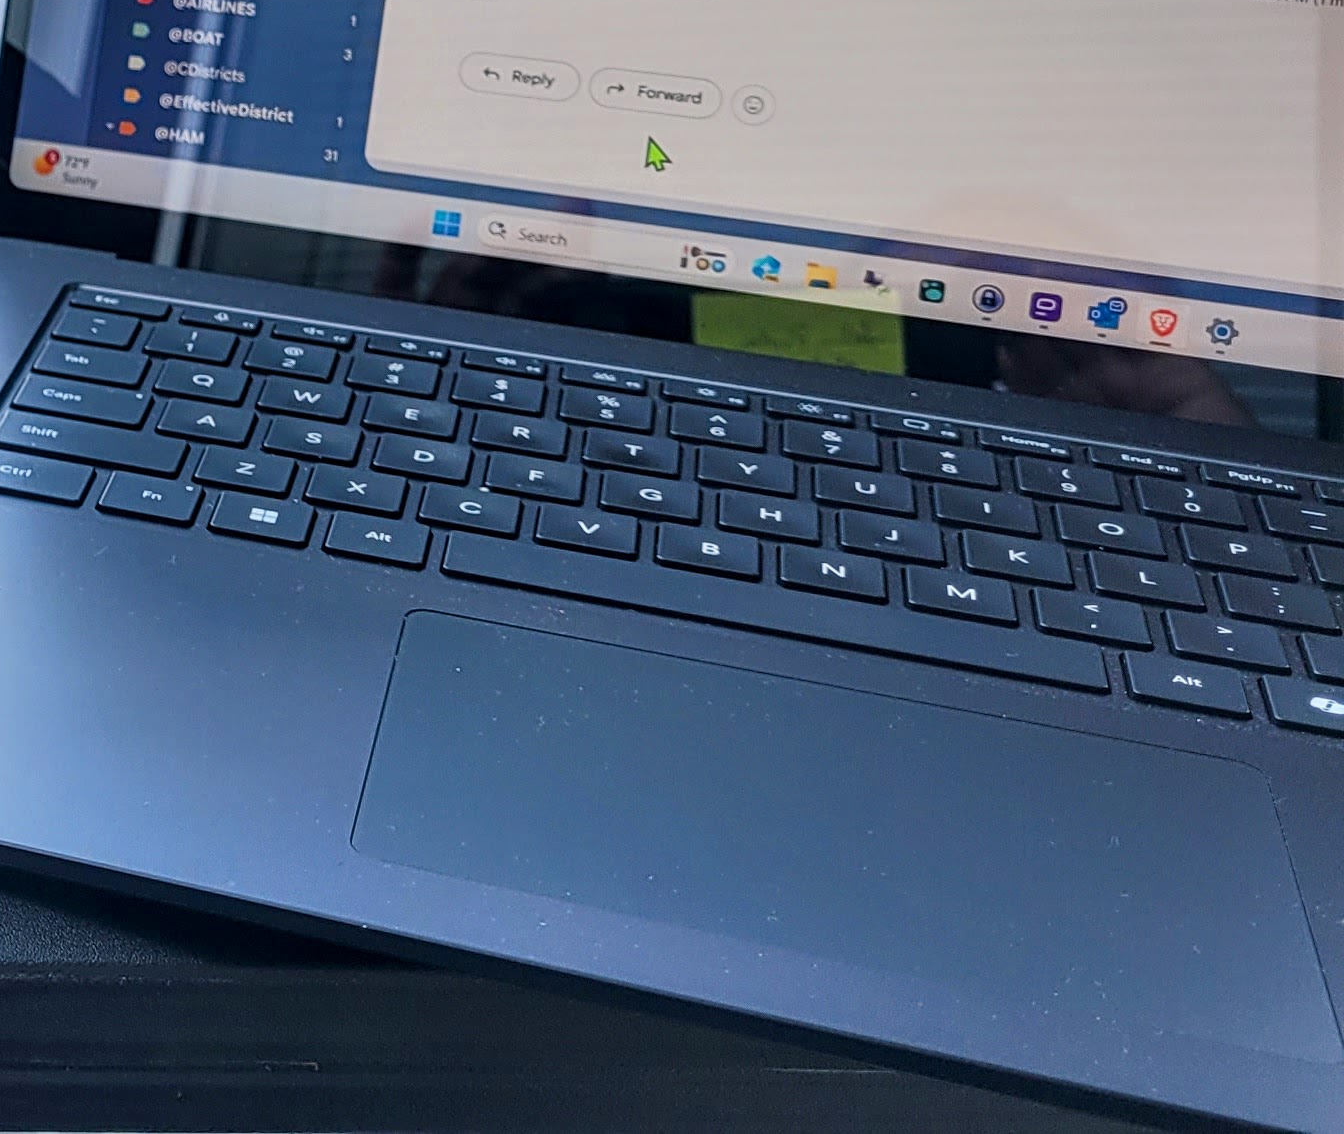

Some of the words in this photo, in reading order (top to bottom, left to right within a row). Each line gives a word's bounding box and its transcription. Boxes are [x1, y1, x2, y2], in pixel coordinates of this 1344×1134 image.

[512, 69, 555, 89] Reply
[637, 84, 703, 105] Forward
[159, 93, 294, 123] @EffectiveDistrict
[154, 125, 206, 145] @HAM
[517, 227, 568, 248] Search
[20, 423, 59, 439] Shift
[0, 464, 33, 479] Ctrl
[365, 529, 392, 544] Alt
[1171, 673, 1204, 688] Alt
